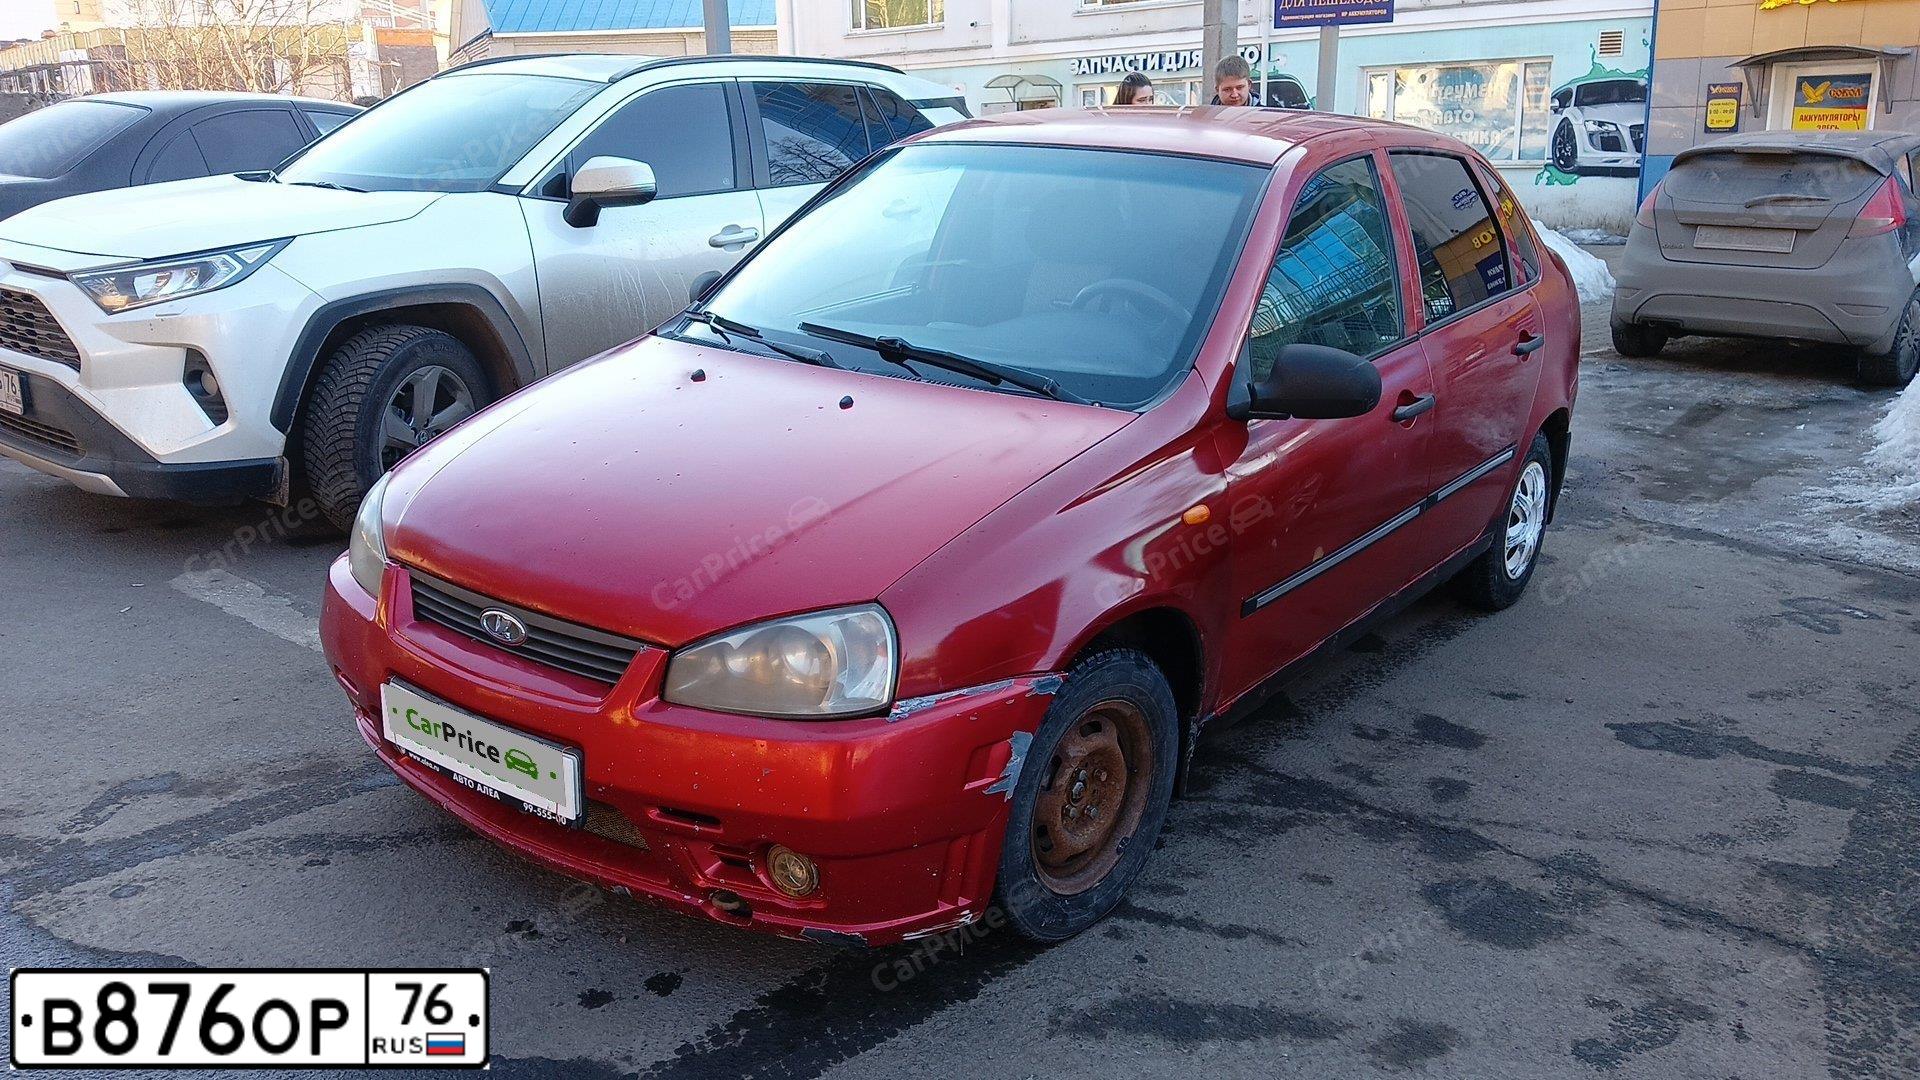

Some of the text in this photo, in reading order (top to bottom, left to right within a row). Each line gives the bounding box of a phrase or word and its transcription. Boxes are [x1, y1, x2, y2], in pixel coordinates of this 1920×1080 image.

[1070, 53, 1161, 75] ЗАПЧАСТИ
[1163, 50, 1203, 72] ДЛЯ
[1799, 113, 1861, 122] АККУМУЛЯТОРЫ
[453, 773, 475, 789] АВТО
[476, 783, 501, 800] АЛЕА
